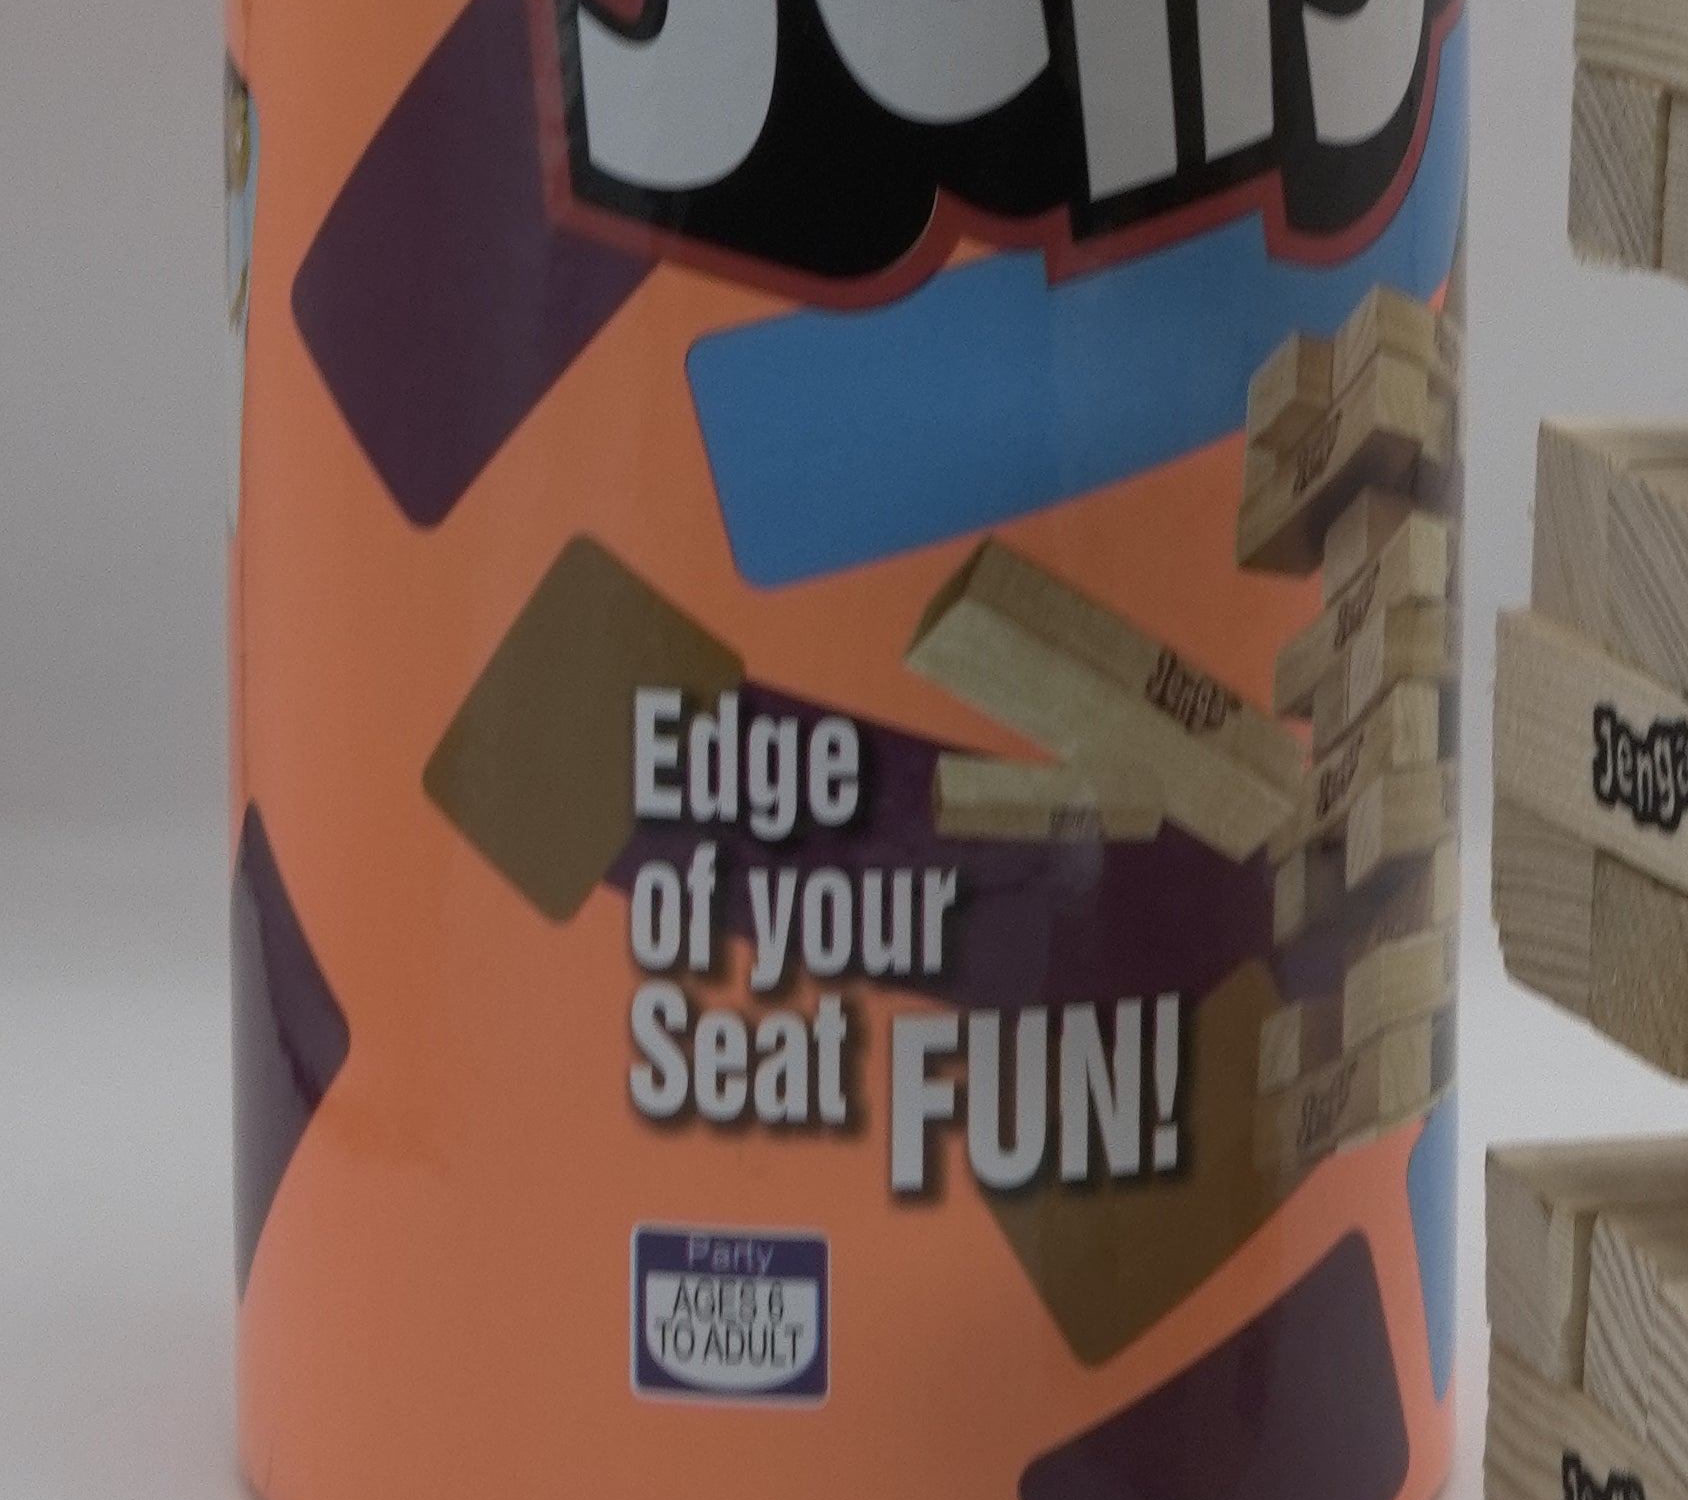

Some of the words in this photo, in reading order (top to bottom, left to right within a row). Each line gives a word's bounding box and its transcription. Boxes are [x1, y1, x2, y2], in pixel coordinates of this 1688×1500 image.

[634, 688, 861, 841] Edge
[630, 842, 716, 971] of
[749, 866, 958, 990] your
[630, 981, 846, 1124] Seat
[891, 992, 1180, 1192] FUN!
[672, 1276, 757, 1323] AGES
[769, 1279, 783, 1323] 6
[689, 1234, 774, 1274] Party
[656, 1317, 695, 1363] TO
[703, 1320, 803, 1368] ADULT
